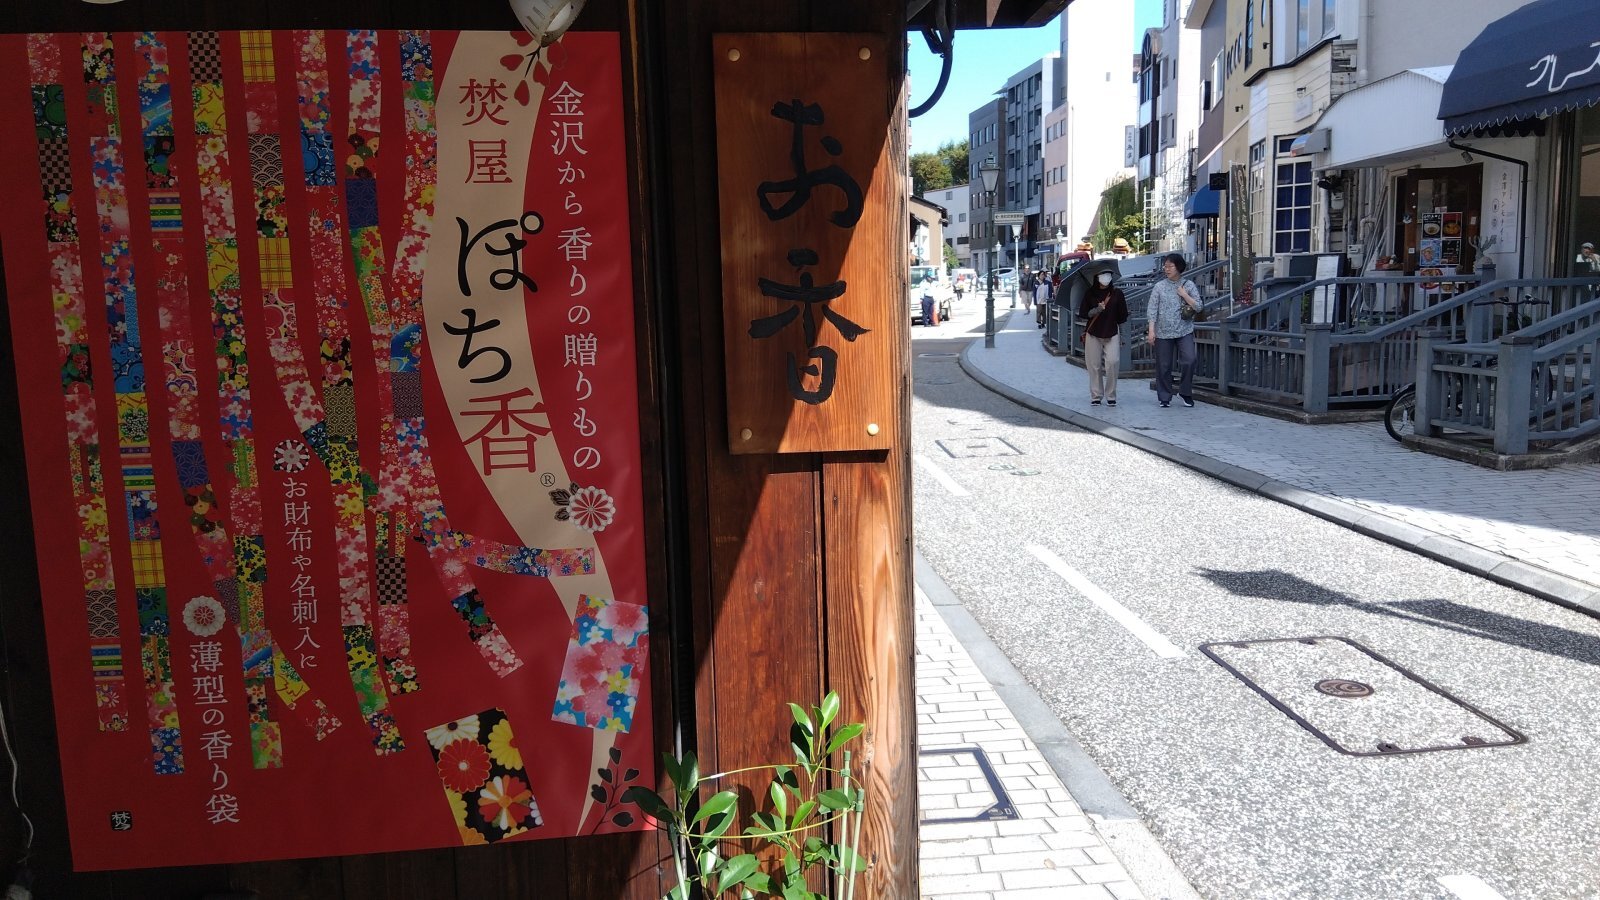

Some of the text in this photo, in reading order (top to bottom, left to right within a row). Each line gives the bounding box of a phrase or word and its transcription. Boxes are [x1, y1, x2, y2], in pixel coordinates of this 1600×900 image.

[548, 81, 601, 470] 金沢から香りの贈りもの
[748, 99, 872, 405] お香
[282, 478, 321, 669] お財布や名刺入に
[190, 641, 240, 825] 薄型の香り袋
